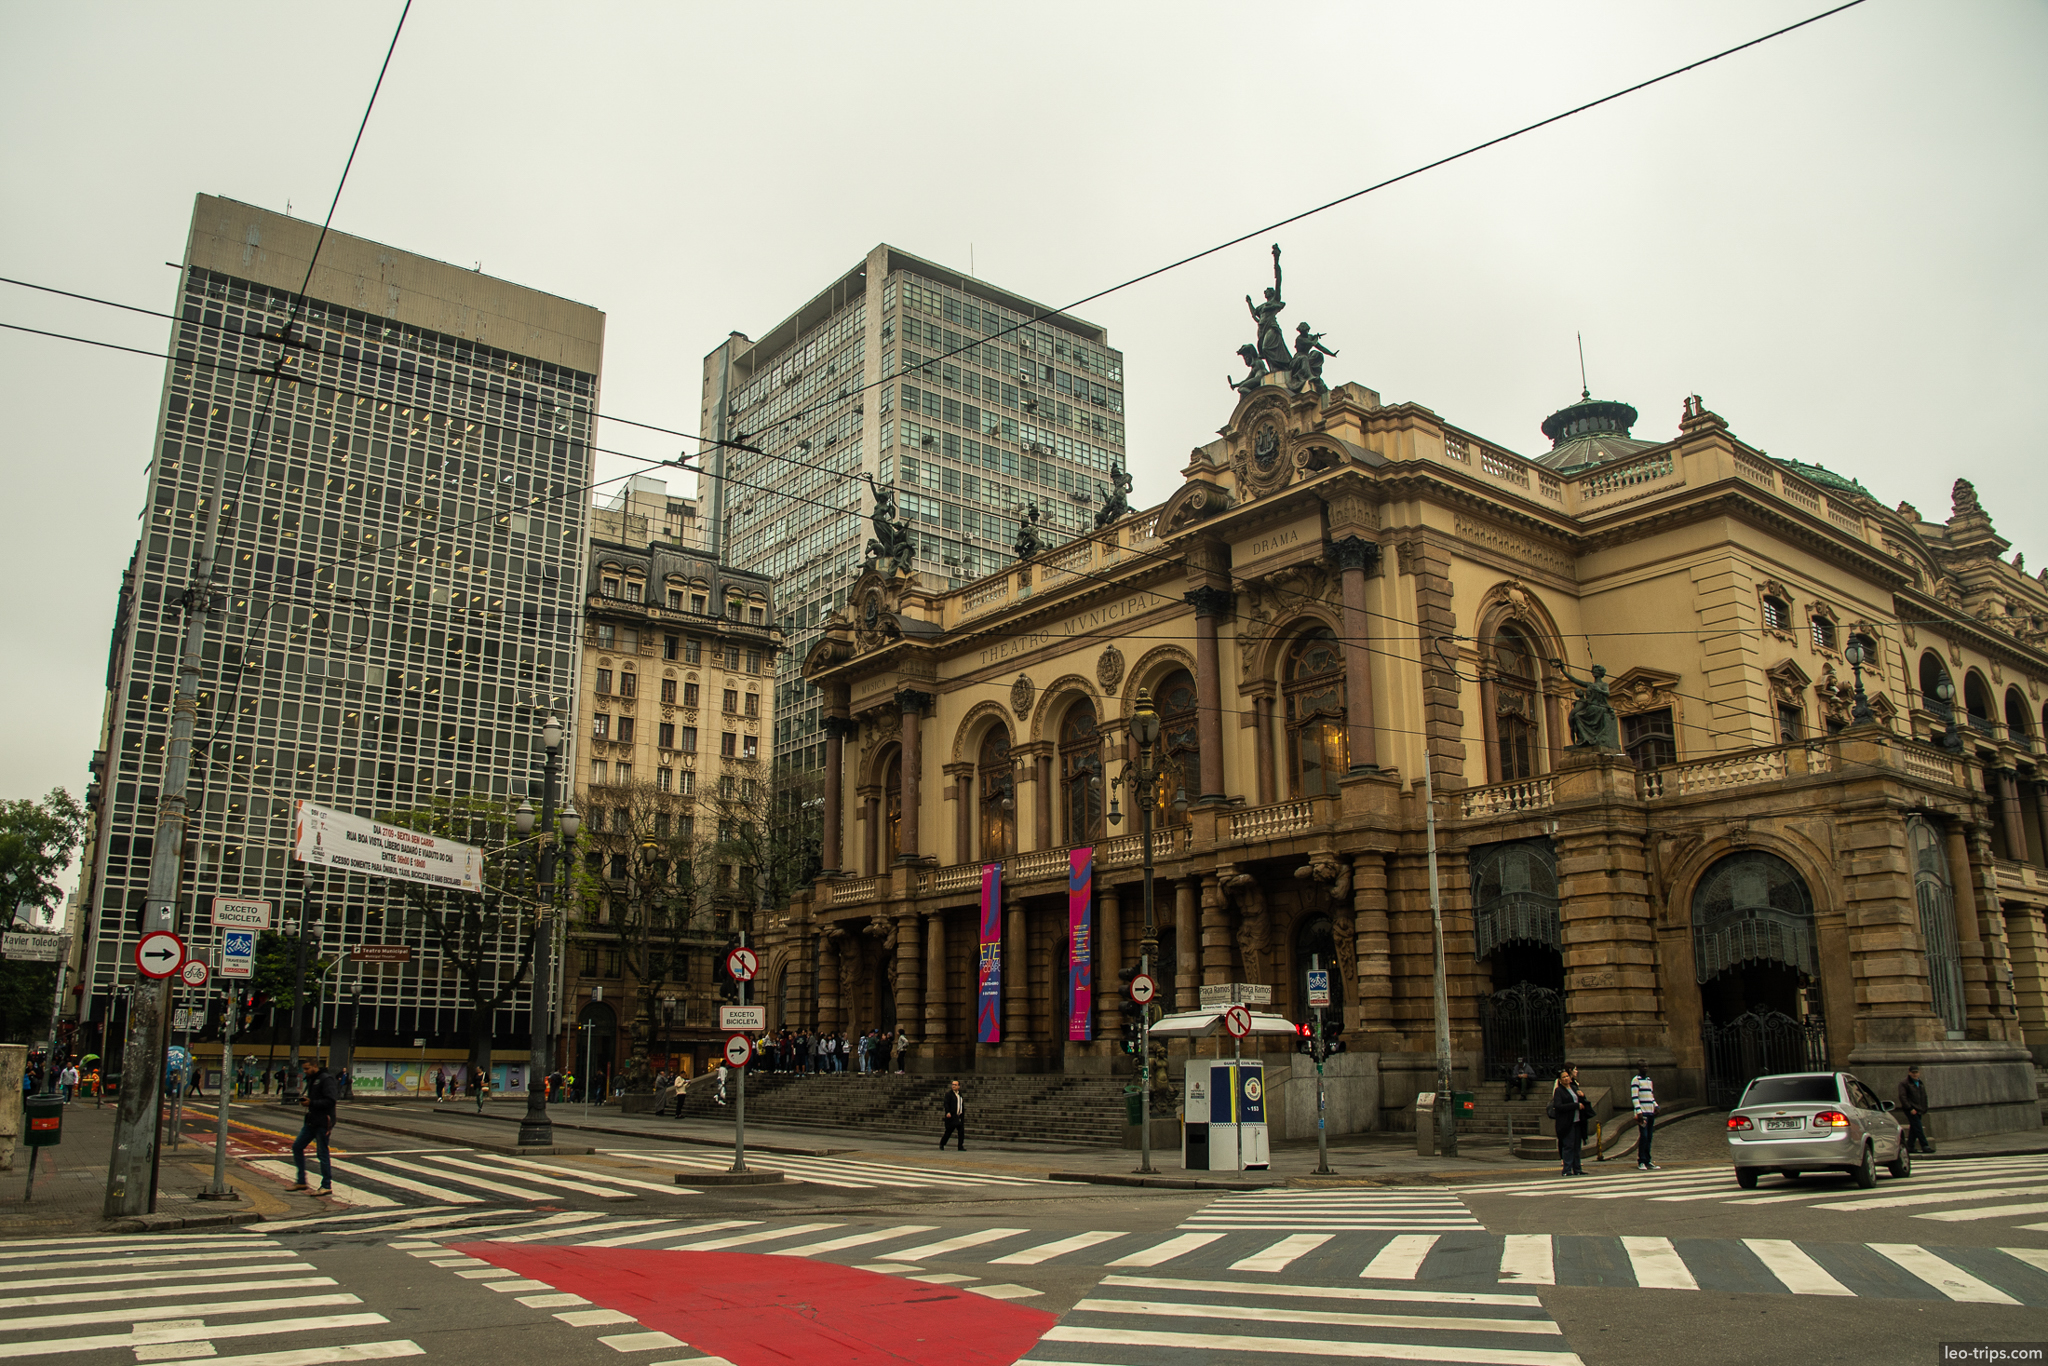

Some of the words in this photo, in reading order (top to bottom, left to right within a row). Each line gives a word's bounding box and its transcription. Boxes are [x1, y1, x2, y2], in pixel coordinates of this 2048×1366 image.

[1253, 530, 1298, 556] DRAMA
[980, 630, 1049, 665] THEATRO
[1064, 593, 1161, 636] MVNICIPAL
[861, 679, 887, 695] MVSICA
[373, 825, 382, 835] DIA
[397, 831, 411, 842] SEXTA
[411, 835, 420, 845] SEM
[421, 837, 434, 847] CARRO
[346, 830, 357, 842] RUA
[357, 833, 368, 844] BOA
[369, 836, 384, 849] VISTA,
[384, 839, 400, 851] LÍBERO
[401, 843, 418, 855] BADARÓ
[418, 848, 422, 856] E
[422, 848, 439, 860] VIADUTO
[439, 852, 445, 861] DO
[445, 854, 453, 863] CHÁ
[381, 851, 396, 862] ENTRE
[410, 858, 413, 866] E
[331, 855, 350, 865] ACESSO
[350, 858, 371, 870] SOMENTE
[371, 862, 382, 872] PARA
[382, 863, 398, 876] ÔNIBUS,
[411, 870, 431, 881] BICICLETAS
[431, 874, 434, 882] E
[434, 875, 443, 883] VANS
[443, 876, 461, 885] ESCOLARES
[224, 905, 258, 914] EXCETO
[219, 913, 261, 923] BICICLETA
[4, 935, 29, 945] Xavier
[32, 937, 58, 947] Toledo
[1200, 987, 1213, 995] Praça
[1241, 985, 1253, 994] Praça
